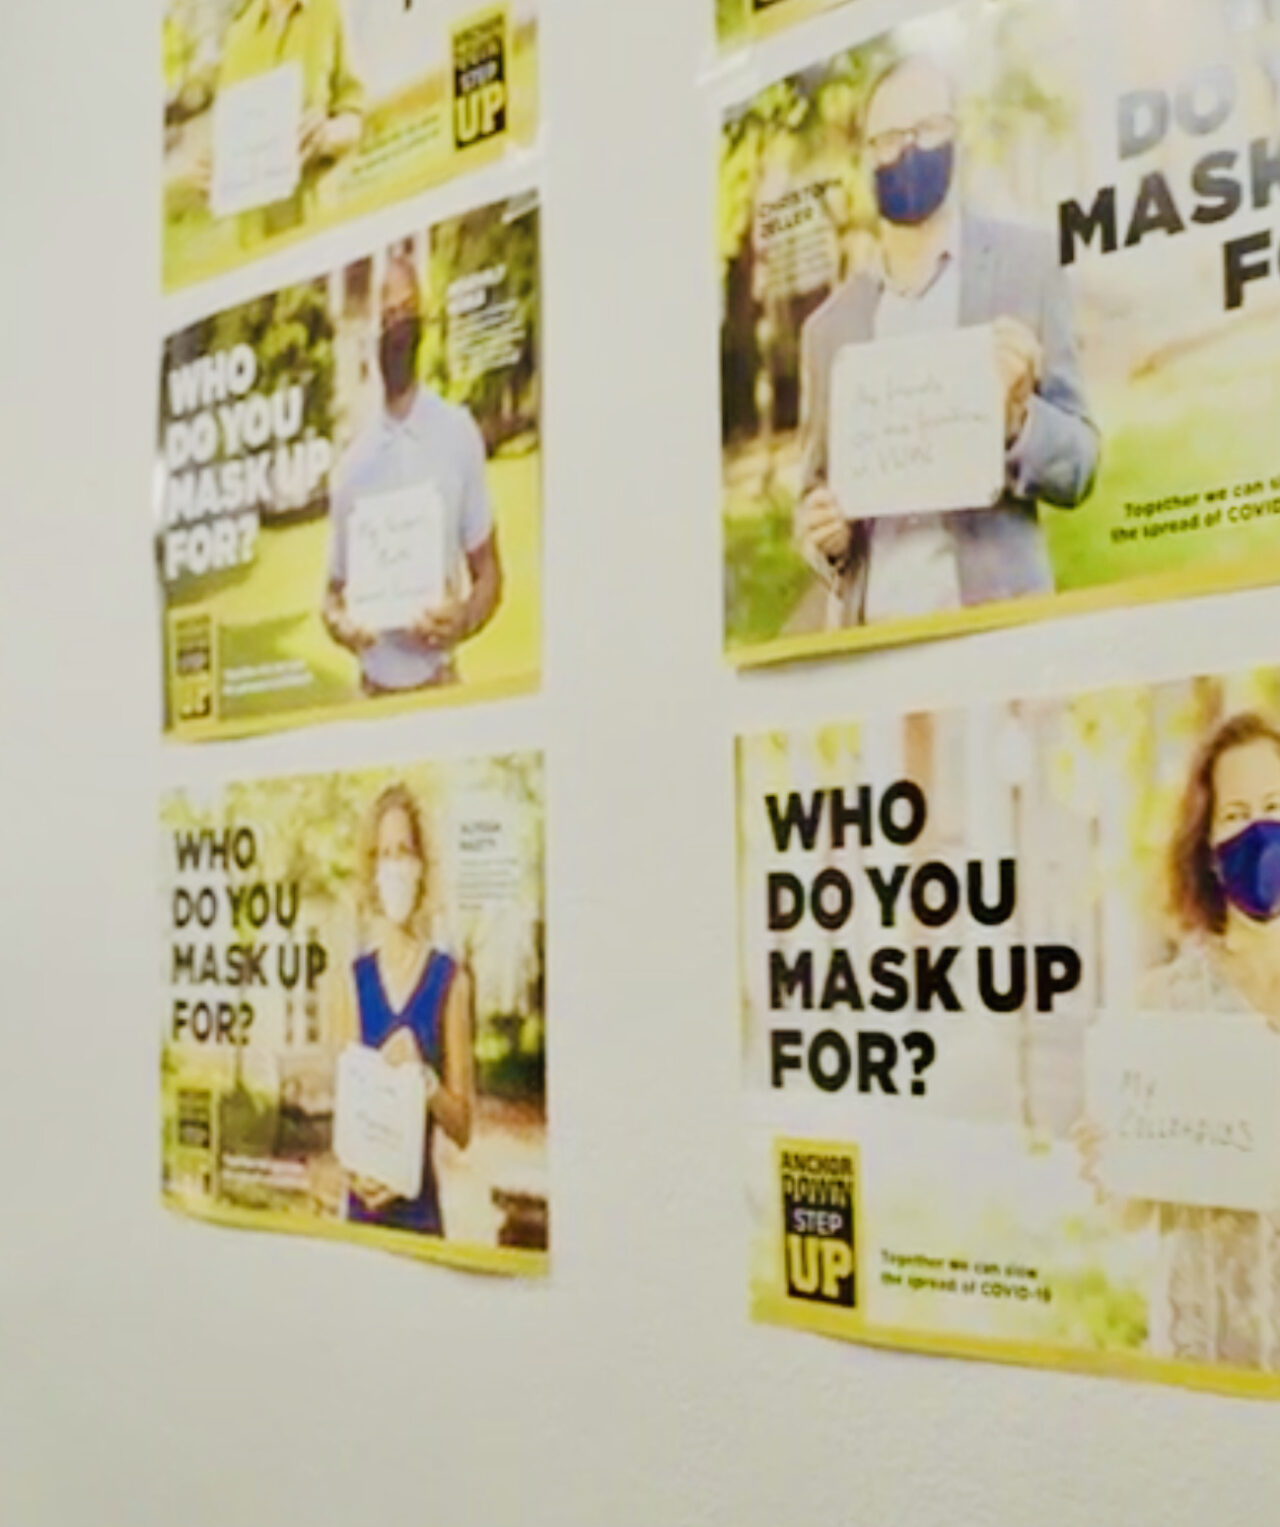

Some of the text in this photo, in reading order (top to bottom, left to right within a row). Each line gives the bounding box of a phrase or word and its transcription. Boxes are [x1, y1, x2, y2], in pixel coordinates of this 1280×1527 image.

[457, 82, 503, 141] UP
[1117, 63, 1237, 160] DO
[168, 343, 257, 417] WHO
[166, 383, 304, 470] DO YOU
[166, 437, 332, 526] MASK UP
[1124, 494, 1200, 519] Together
[1204, 488, 1228, 504] we
[1233, 480, 1264, 498] can
[165, 510, 261, 580] FOR?
[1204, 508, 1222, 528] of
[764, 779, 927, 852] WHO
[174, 827, 257, 872] WHO
[173, 880, 299, 930] DO YOU
[767, 858, 1017, 931] DO YOU
[172, 943, 328, 991] MASK UP
[769, 944, 1083, 1013] MASK UP
[172, 1000, 255, 1046] FOR?
[770, 1028, 937, 1096] FOR?
[793, 1208, 843, 1236] STEP
[788, 1234, 853, 1300] UP
